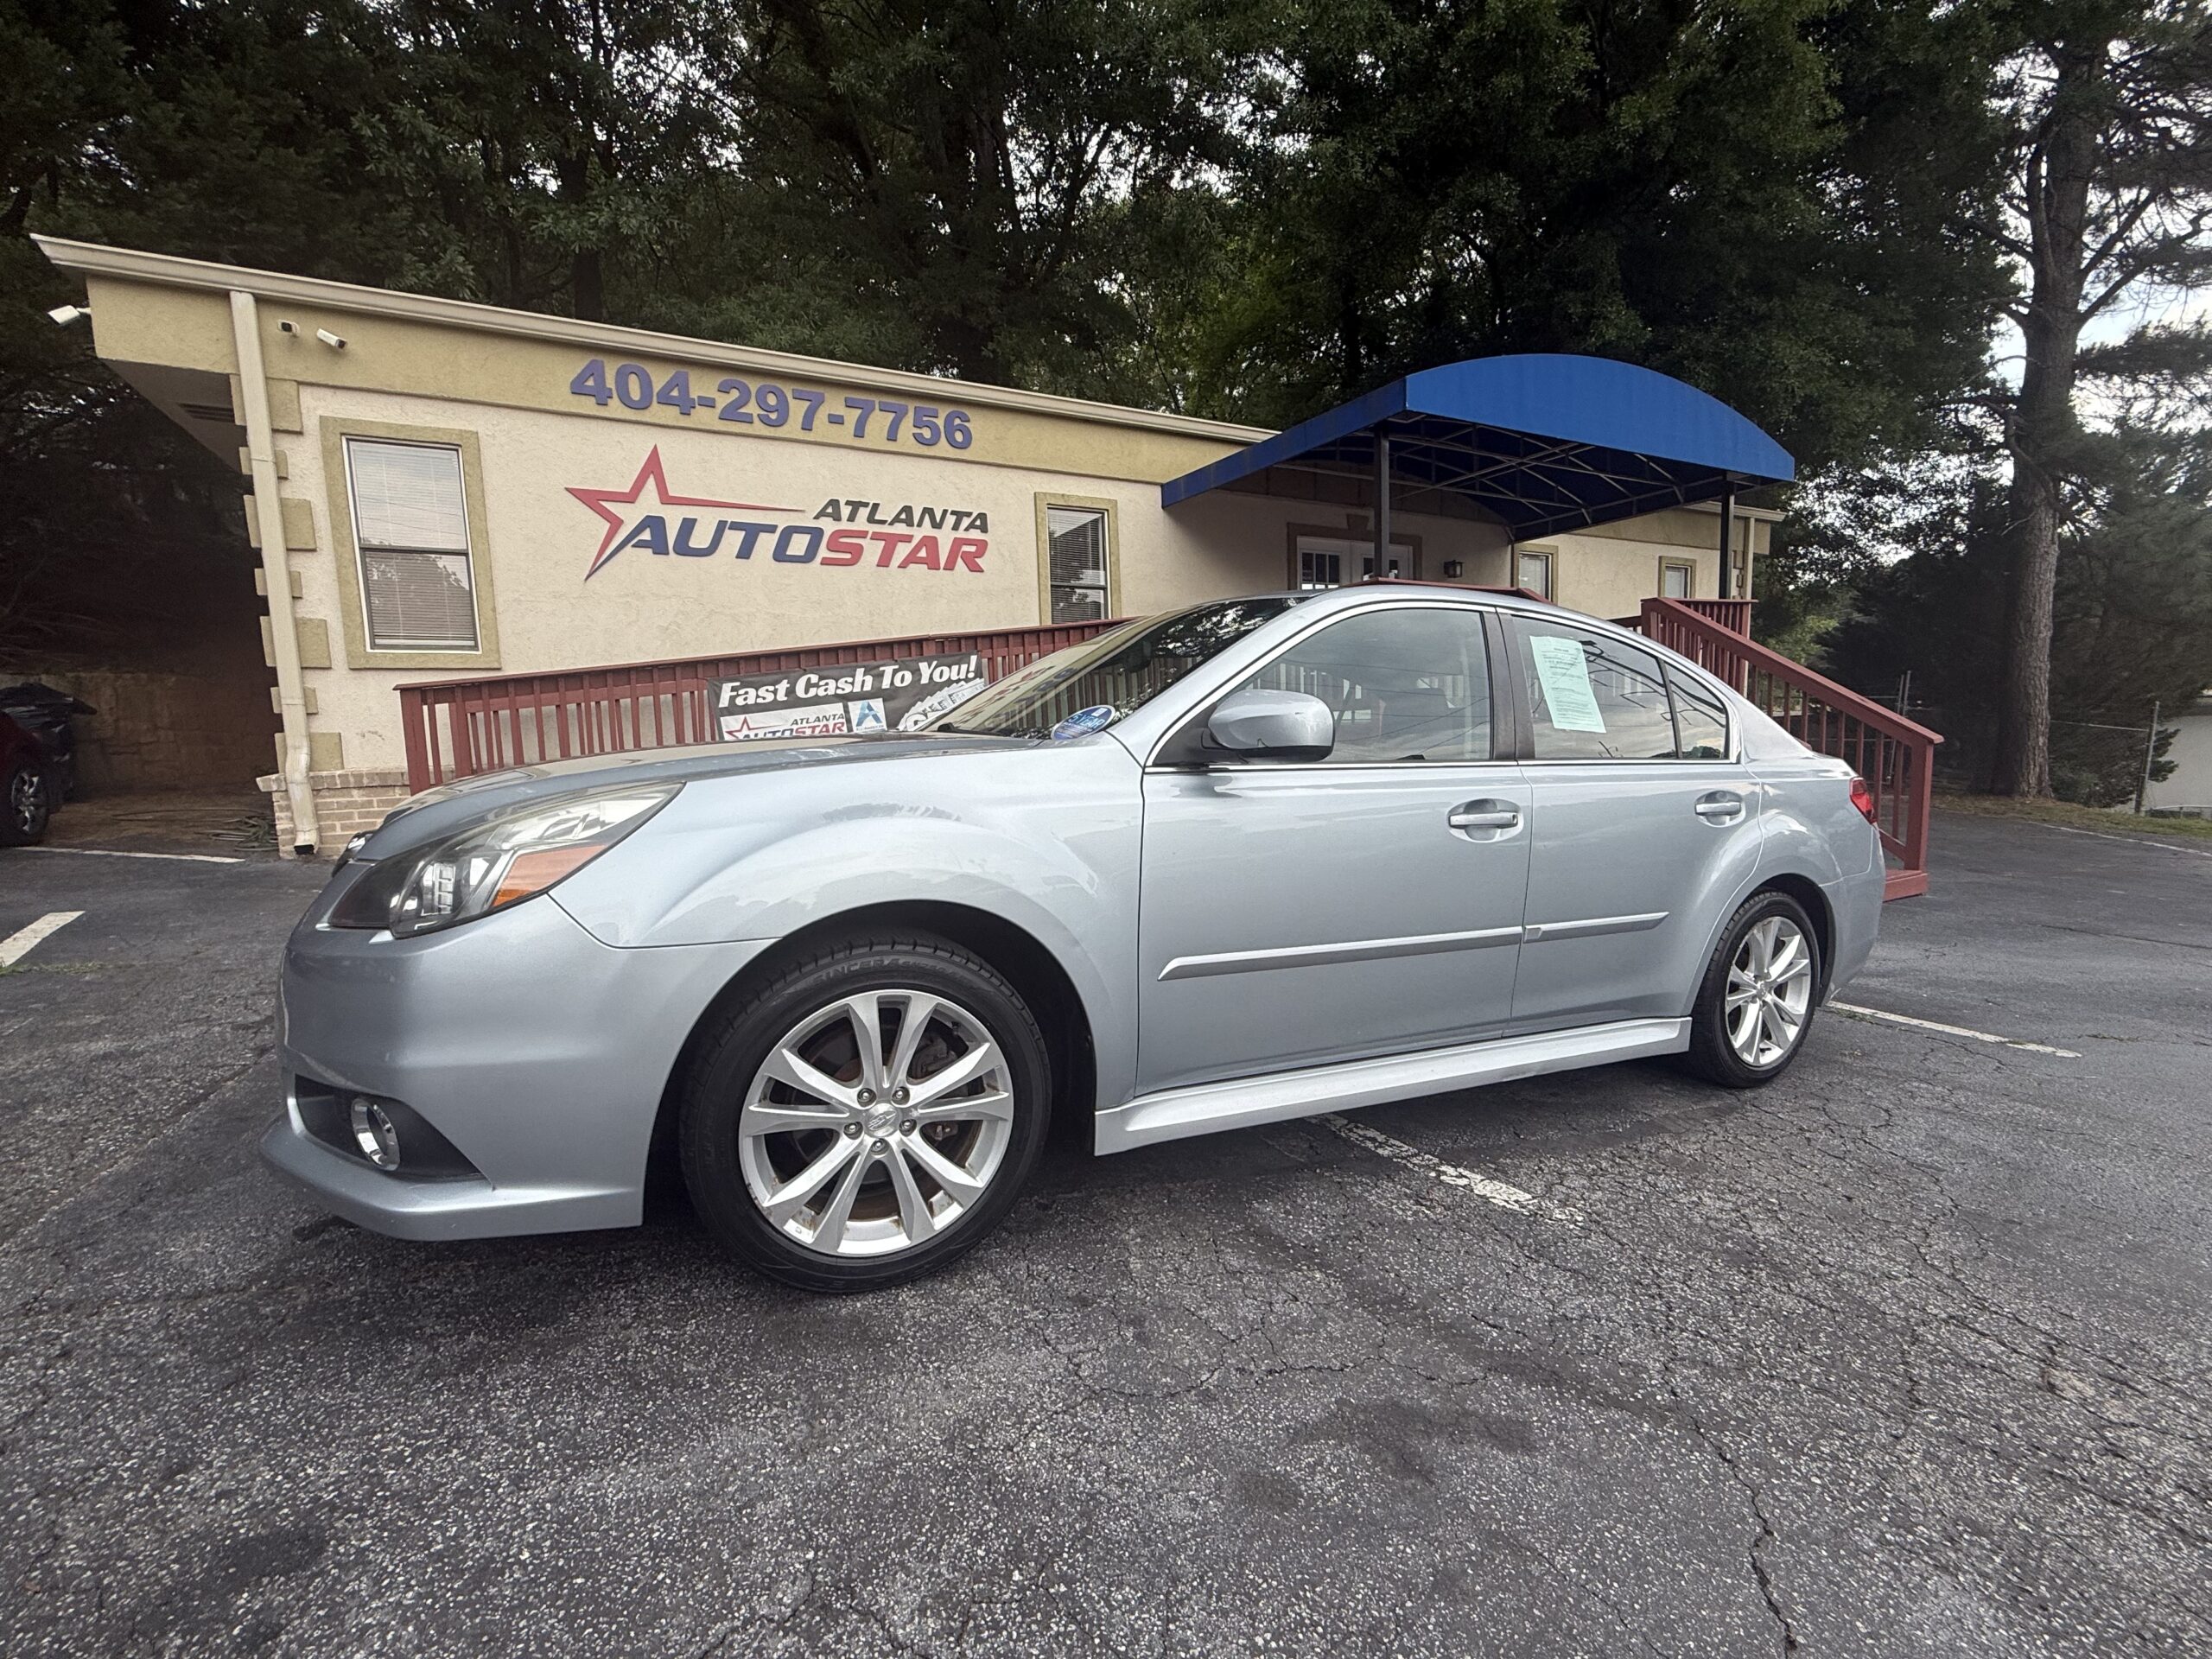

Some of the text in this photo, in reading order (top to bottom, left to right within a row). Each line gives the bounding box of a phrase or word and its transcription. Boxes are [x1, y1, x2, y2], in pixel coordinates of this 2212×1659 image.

[569, 359, 973, 449] 404-297-7756
[813, 499, 988, 533] ATLANTA
[585, 515, 988, 582] AUTOSTAR
[718, 655, 977, 709] Fast Cash To You!
[791, 713, 845, 726] ATLANTA
